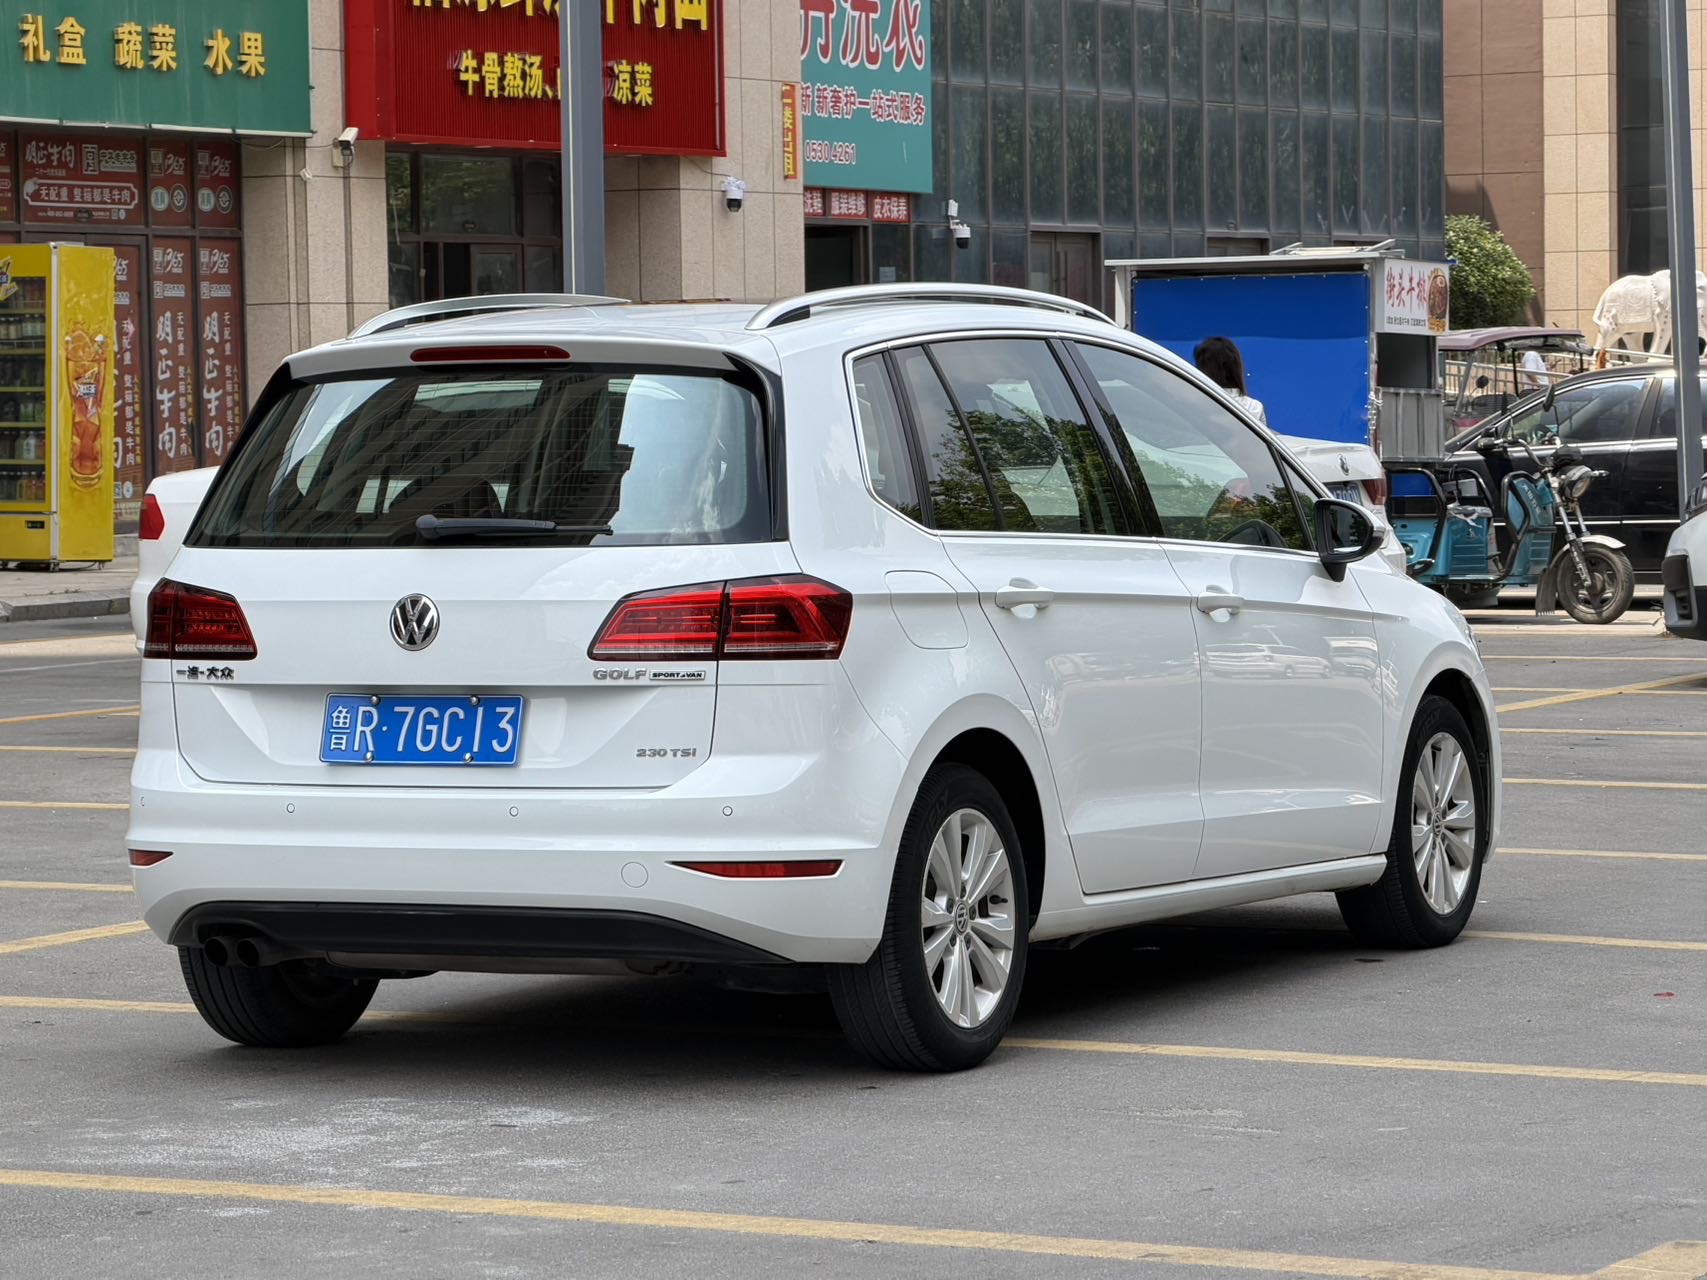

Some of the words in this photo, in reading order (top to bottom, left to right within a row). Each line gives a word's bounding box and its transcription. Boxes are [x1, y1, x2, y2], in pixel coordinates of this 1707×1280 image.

[18, 13, 86, 65] 礼盒
[113, 20, 177, 72] 蔬菜
[204, 28, 266, 77] 水果
[459, 49, 560, 99] 牛骨熬汤、
[613, 60, 654, 107] 凉菜
[804, 140, 829, 162] 0530
[831, 142, 856, 164] 4261
[592, 669, 647, 680] GOLF
[636, 748, 667, 758] 230
